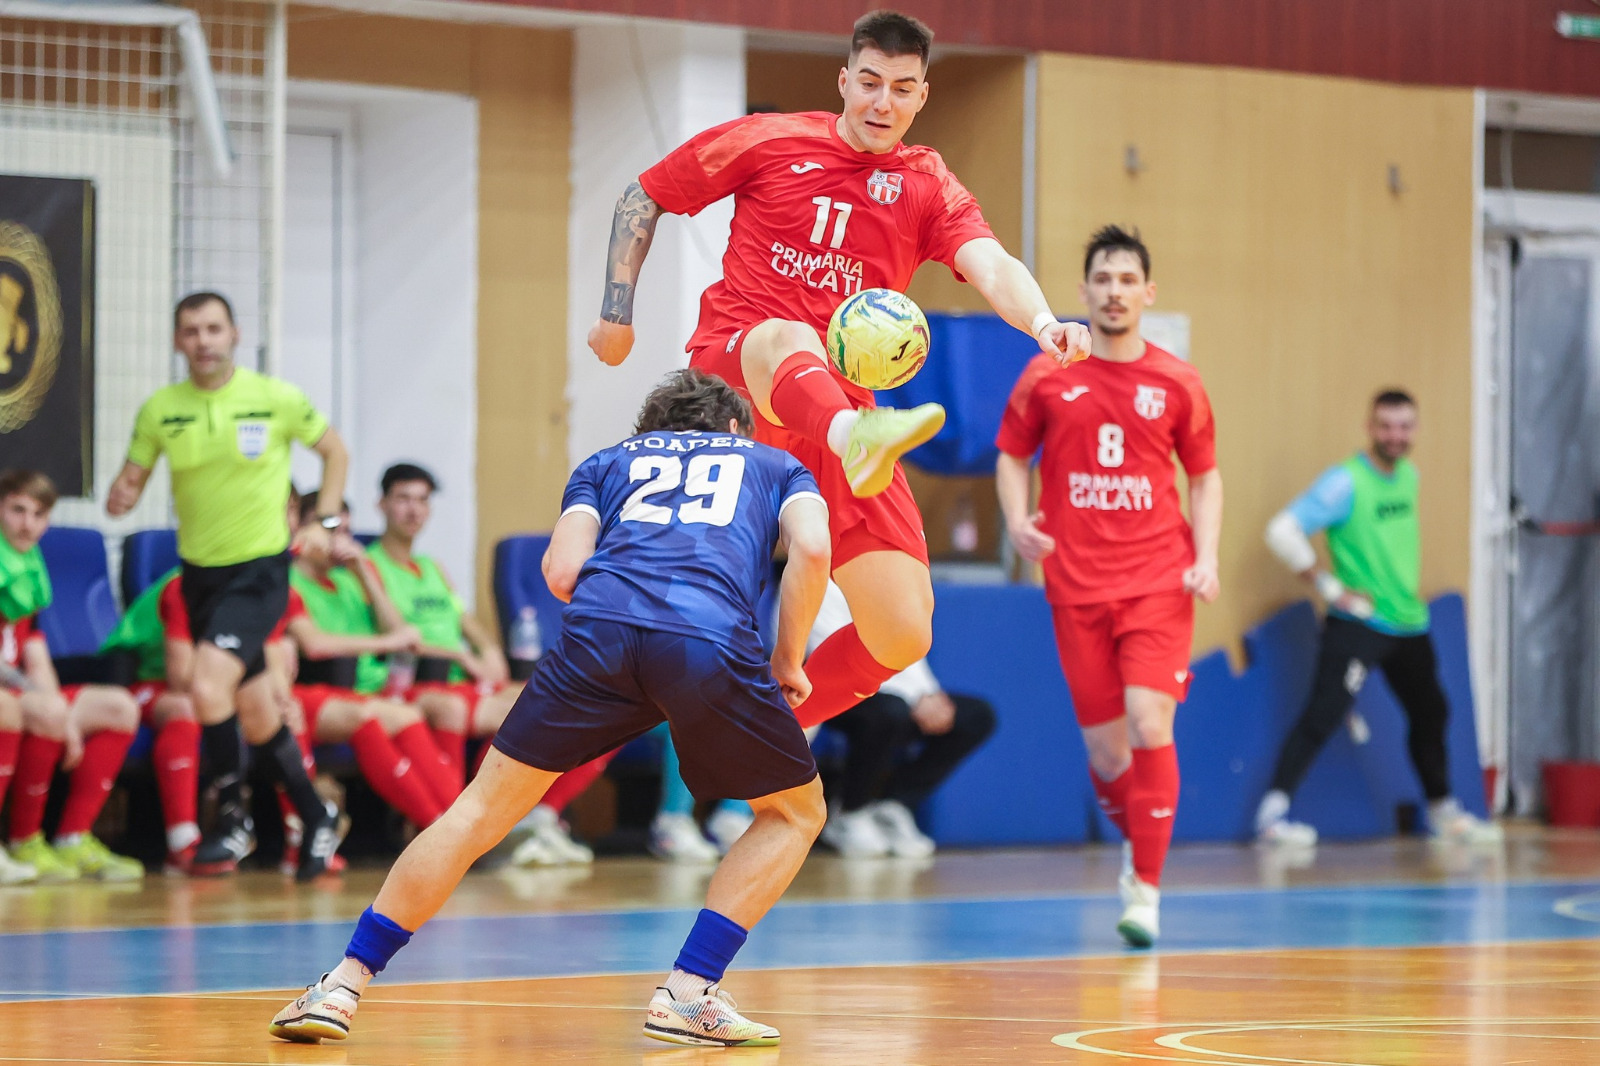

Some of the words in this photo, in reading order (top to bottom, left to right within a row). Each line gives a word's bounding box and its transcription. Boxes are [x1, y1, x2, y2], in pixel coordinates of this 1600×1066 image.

[809, 196, 852, 249] 11
[1097, 423, 1125, 468] 8
[619, 453, 746, 527] 29
